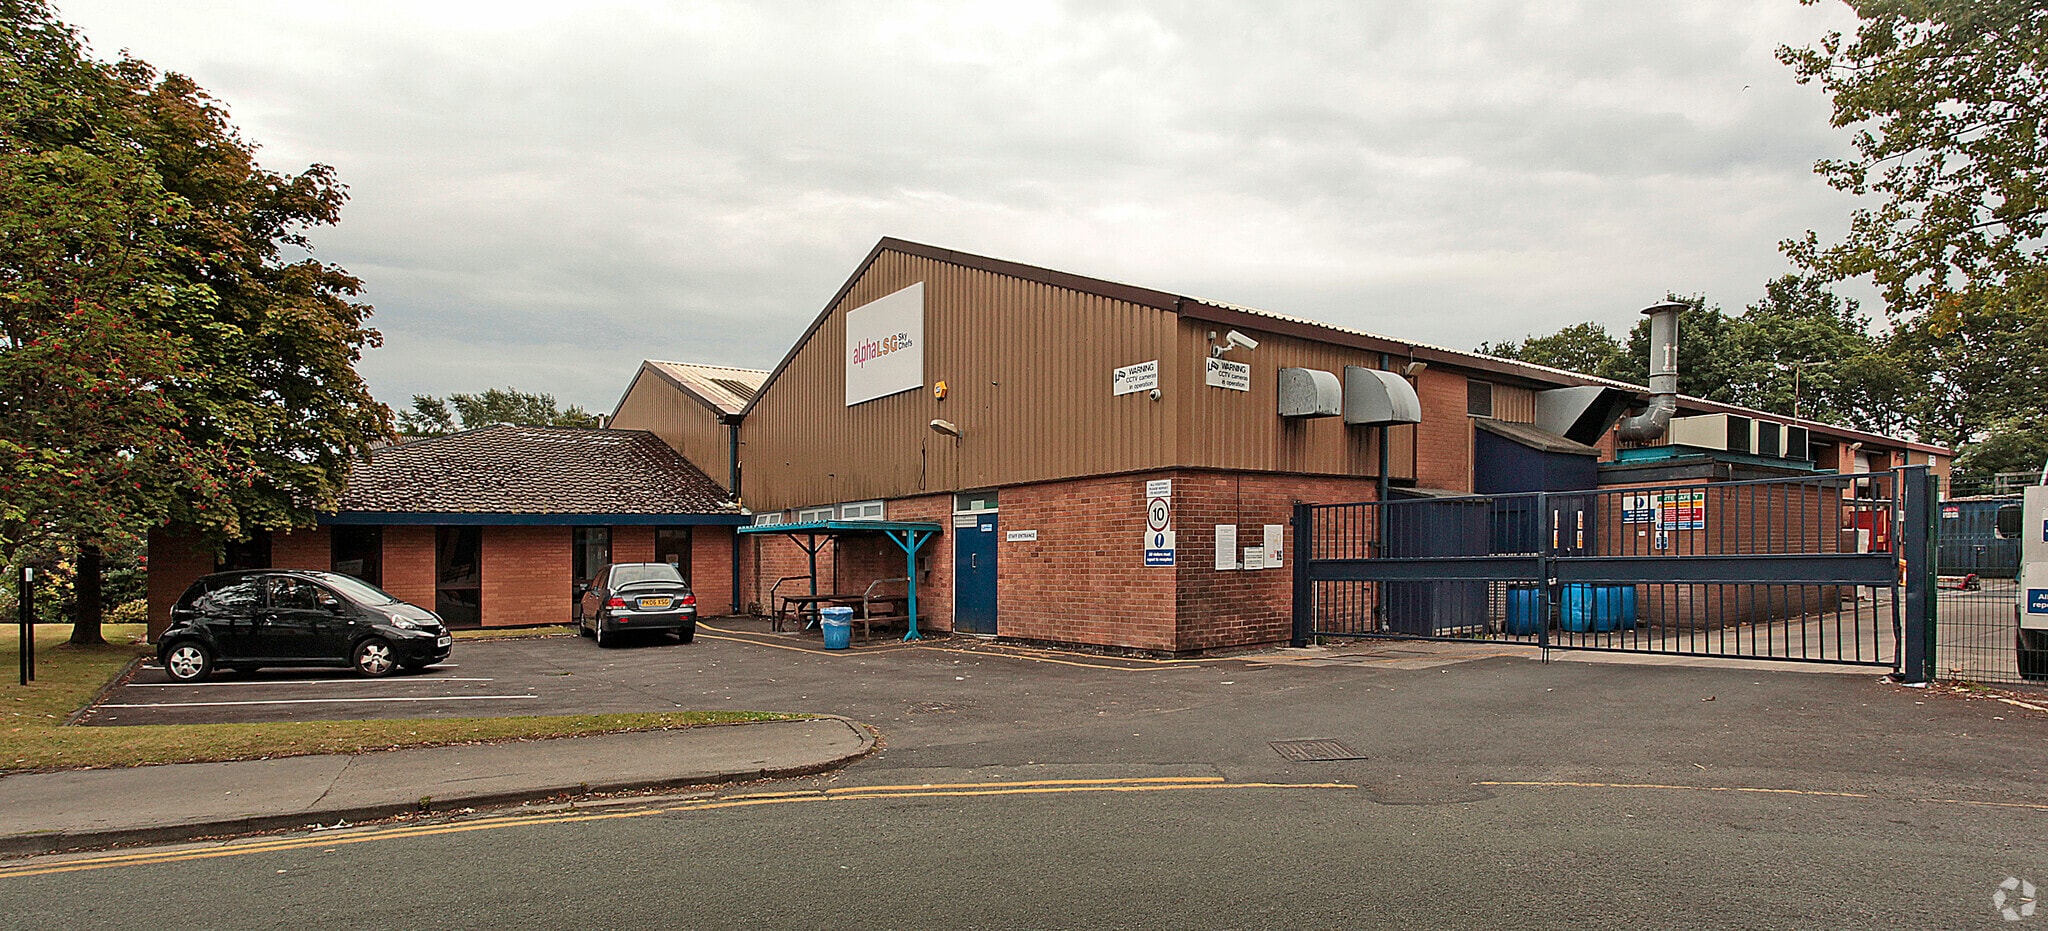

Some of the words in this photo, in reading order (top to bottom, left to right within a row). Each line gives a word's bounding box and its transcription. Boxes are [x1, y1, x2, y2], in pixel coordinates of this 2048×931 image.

[898, 333, 907, 341] Sky
[898, 340, 912, 350] Chefs
[1128, 363, 1154, 375] WARNING
[1221, 362, 1246, 373] WARNING
[1139, 373, 1156, 381] cameras
[1134, 381, 1153, 389] operation
[1153, 507, 1165, 521] 10
